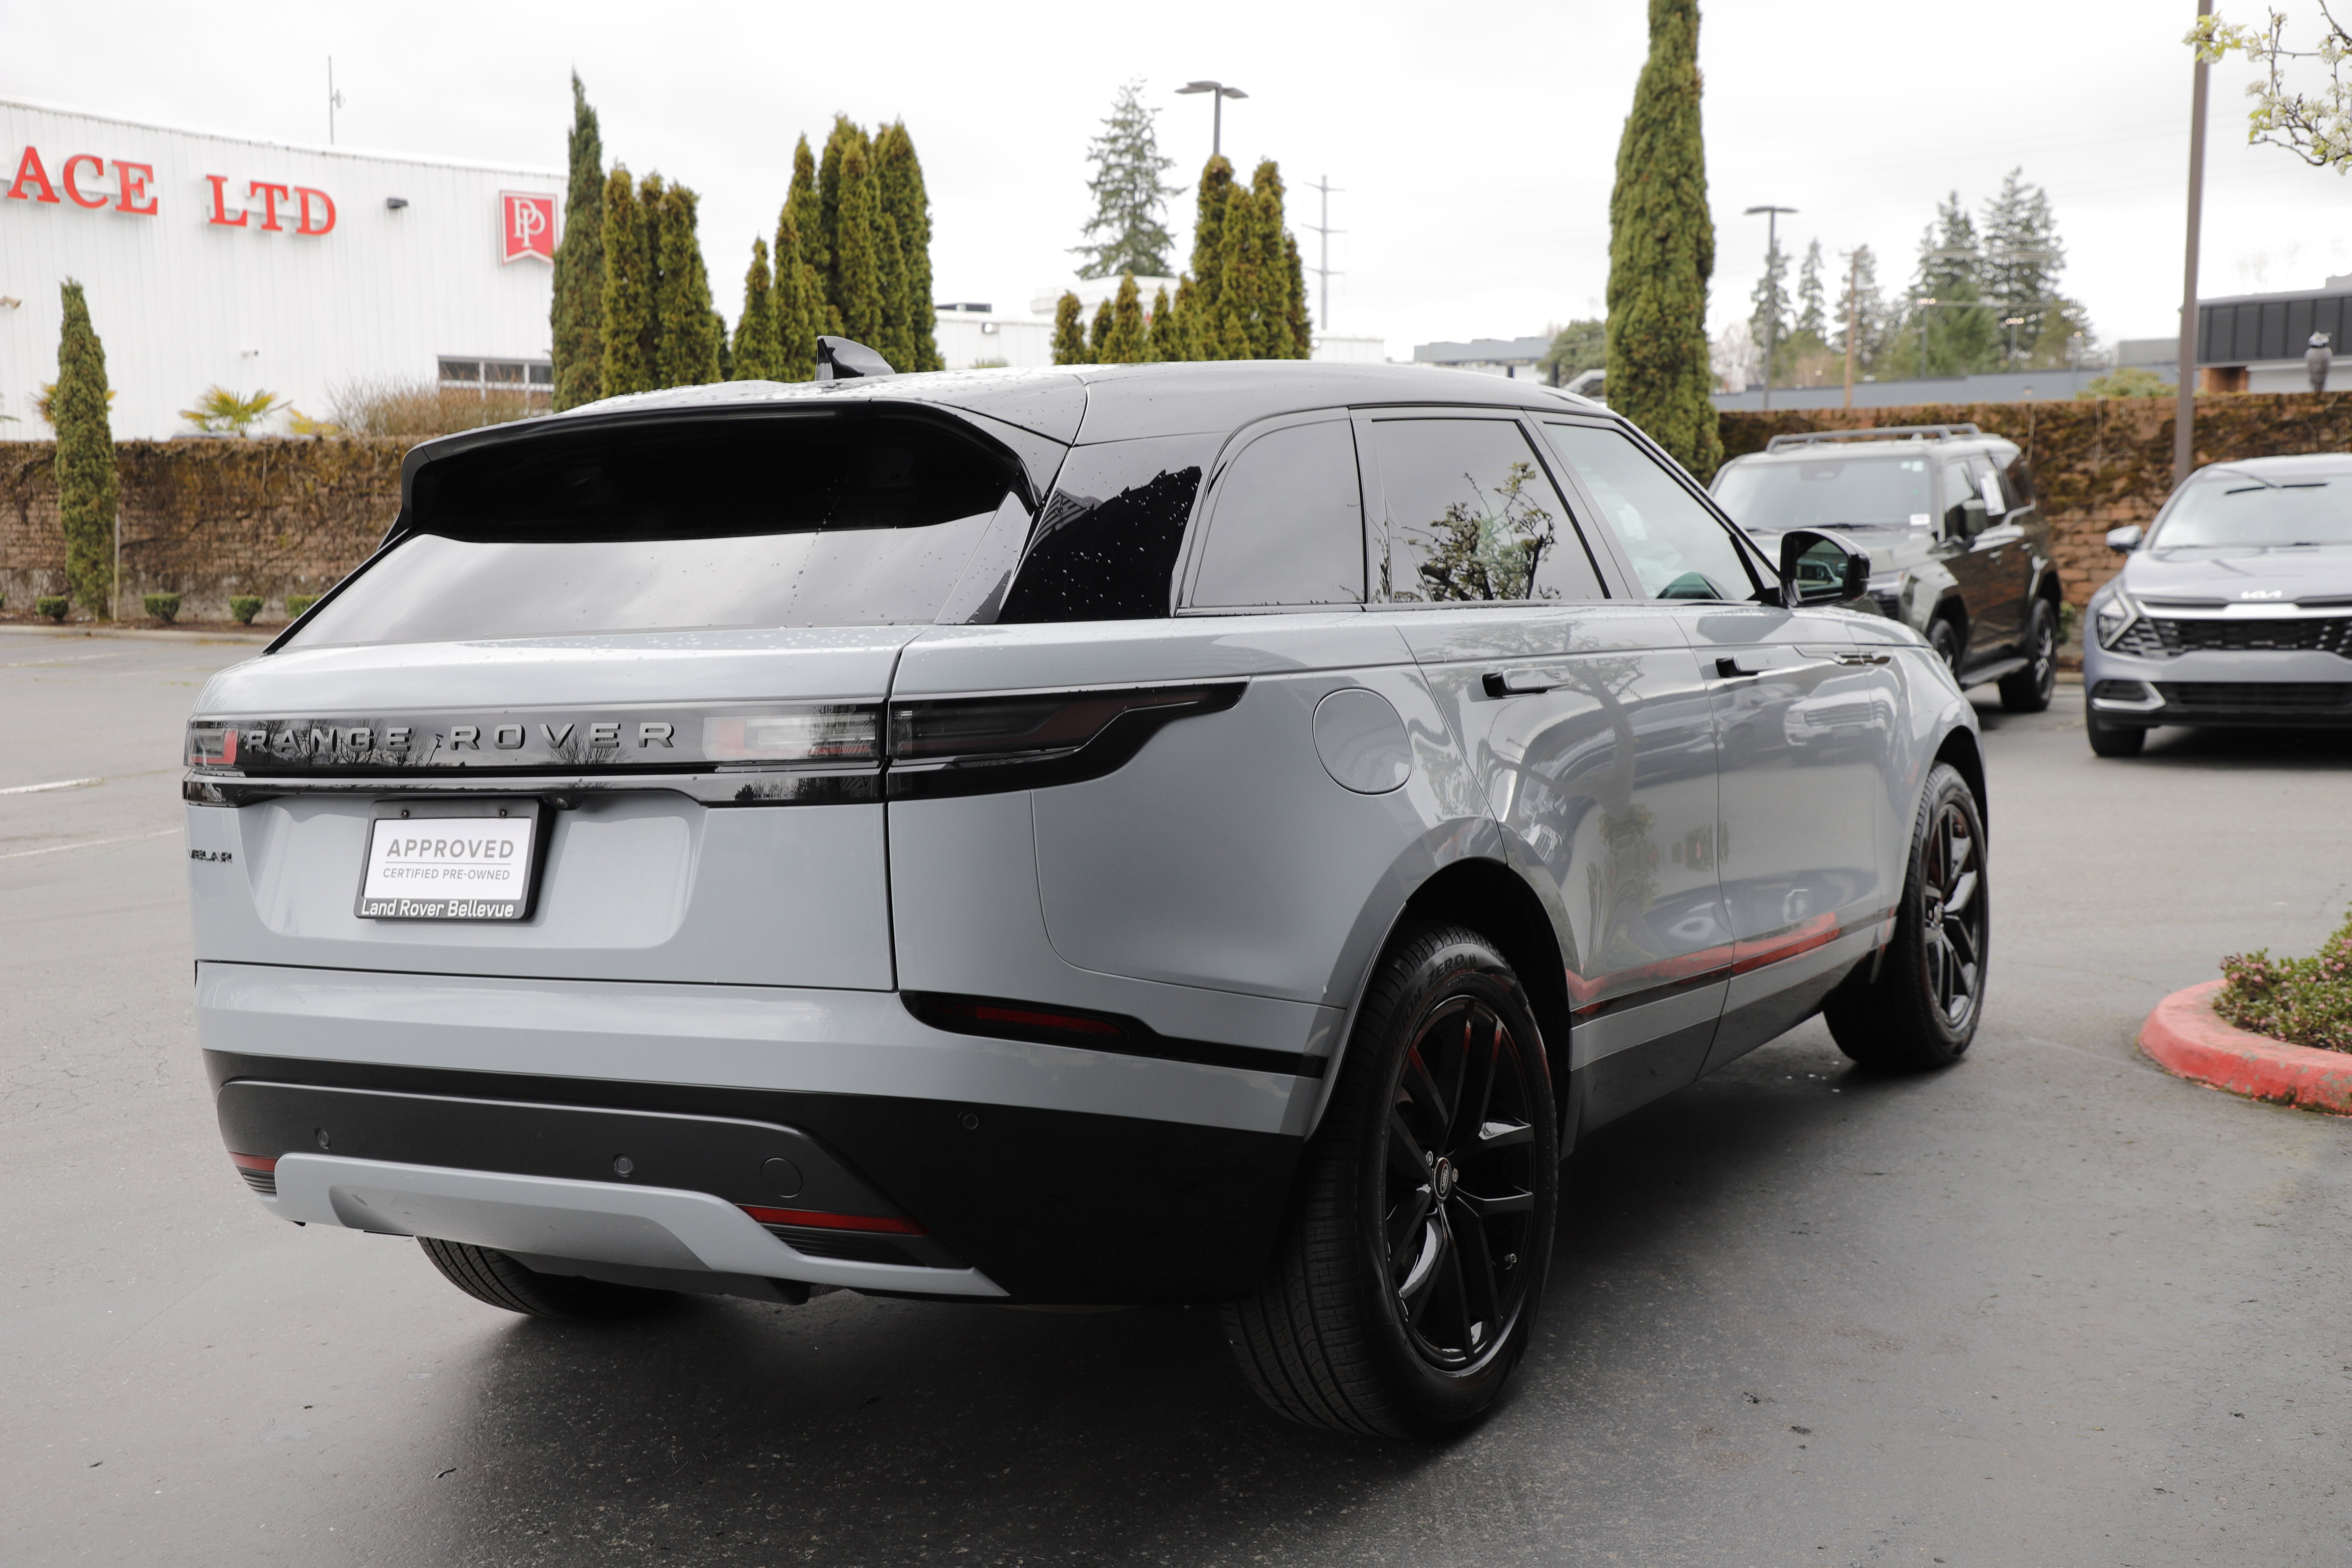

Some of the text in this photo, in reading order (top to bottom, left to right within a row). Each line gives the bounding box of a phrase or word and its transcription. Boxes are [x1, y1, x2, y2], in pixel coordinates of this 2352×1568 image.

[7, 145, 336, 236] ACE LTD
[248, 722, 675, 754] RANGE ROVER
[188, 847, 233, 862] VELAR
[386, 839, 514, 858] APPROVED
[383, 868, 510, 880] CERTIFIED PRE-OWNED
[361, 898, 514, 918] Land Rover Bellevue
[1426, 953, 1465, 989] ZERO
